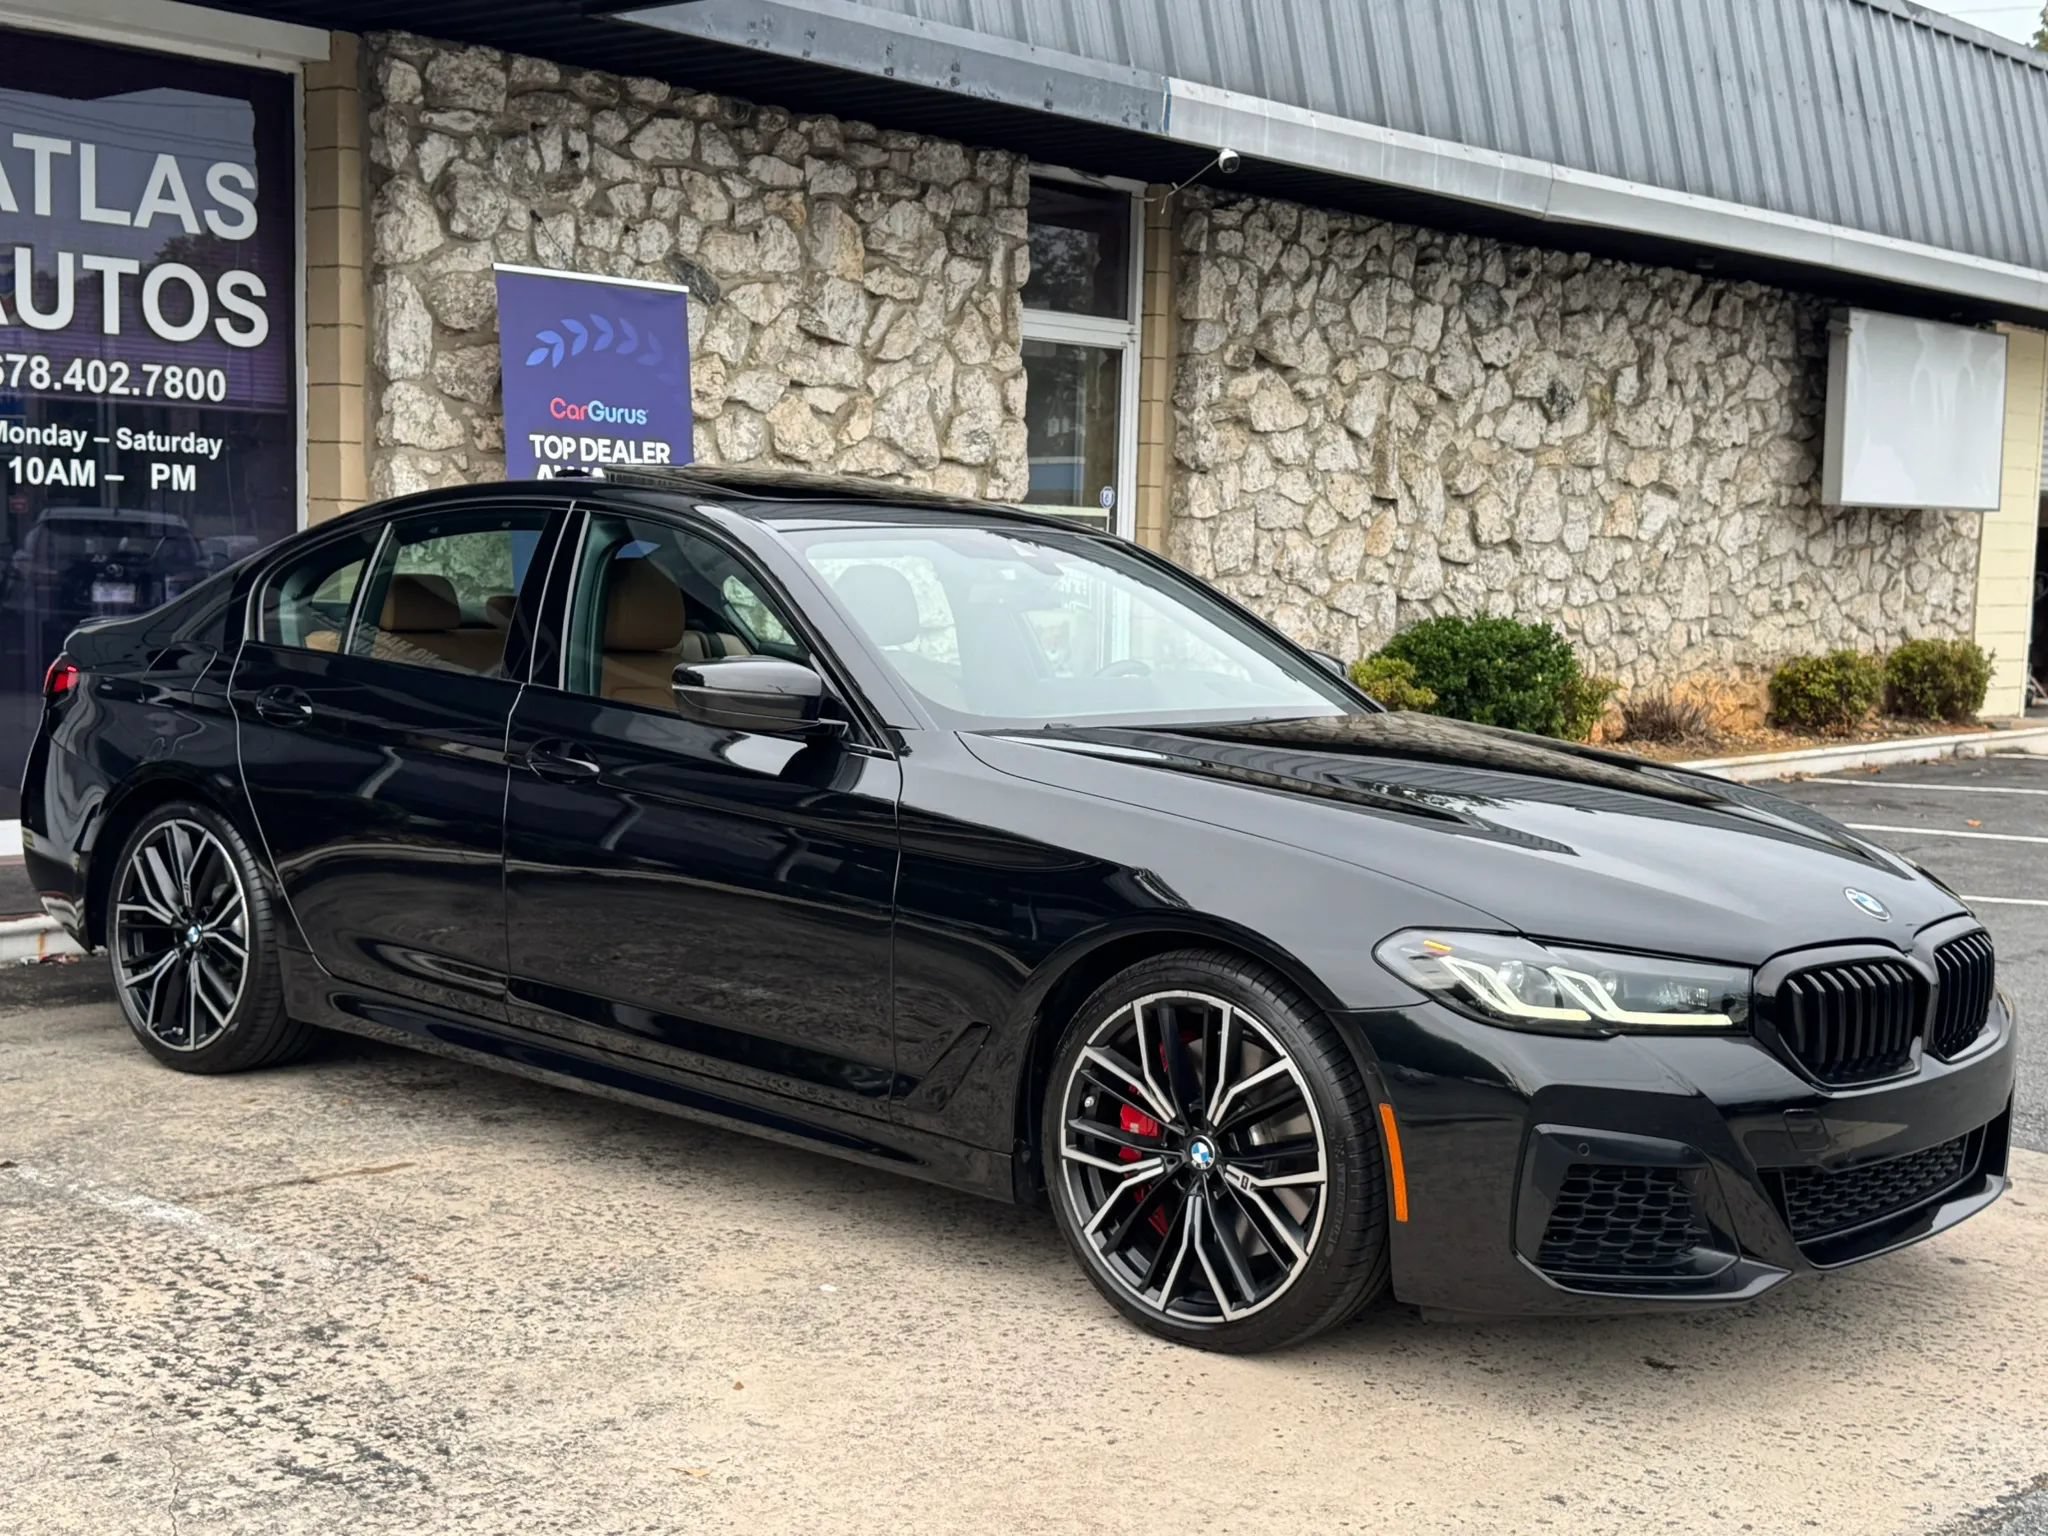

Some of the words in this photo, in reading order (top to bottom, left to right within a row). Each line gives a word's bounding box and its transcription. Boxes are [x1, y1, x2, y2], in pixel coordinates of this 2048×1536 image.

[0, 132, 258, 240] TLAS
[0, 246, 269, 348] UTOS
[0, 353, 226, 402] 78.402.7800
[550, 397, 648, 425] CarGurus
[116, 427, 223, 460] Saturday
[529, 434, 577, 460] TOP
[580, 437, 671, 464] DEALER
[8, 456, 96, 488] 10AM
[151, 463, 196, 491] PM
